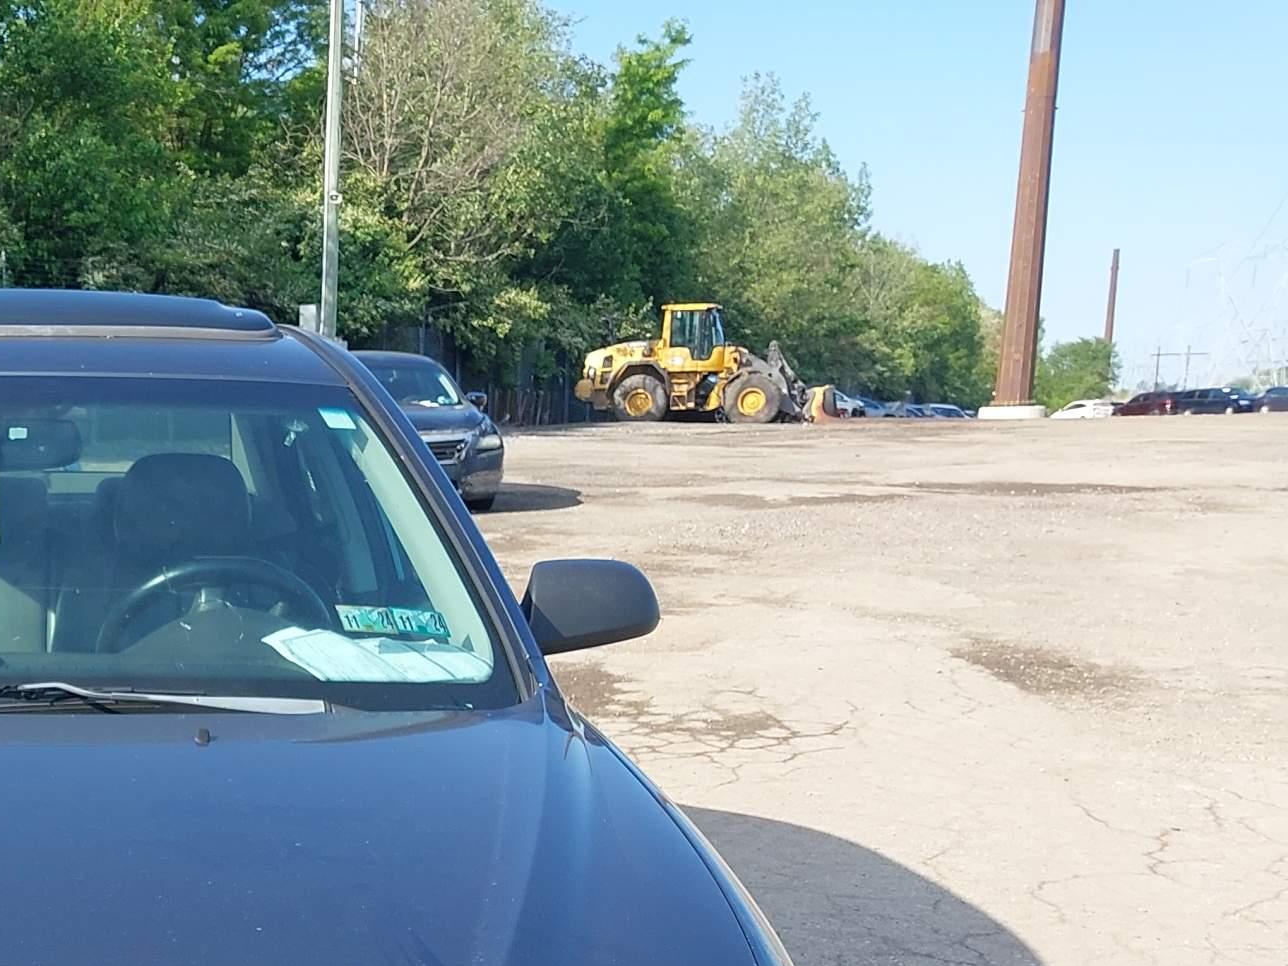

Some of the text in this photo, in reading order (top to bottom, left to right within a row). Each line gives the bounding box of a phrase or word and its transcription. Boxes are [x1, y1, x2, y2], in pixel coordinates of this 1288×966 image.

[344, 610, 394, 630] 11 24
[398, 613, 446, 633] 11 24
